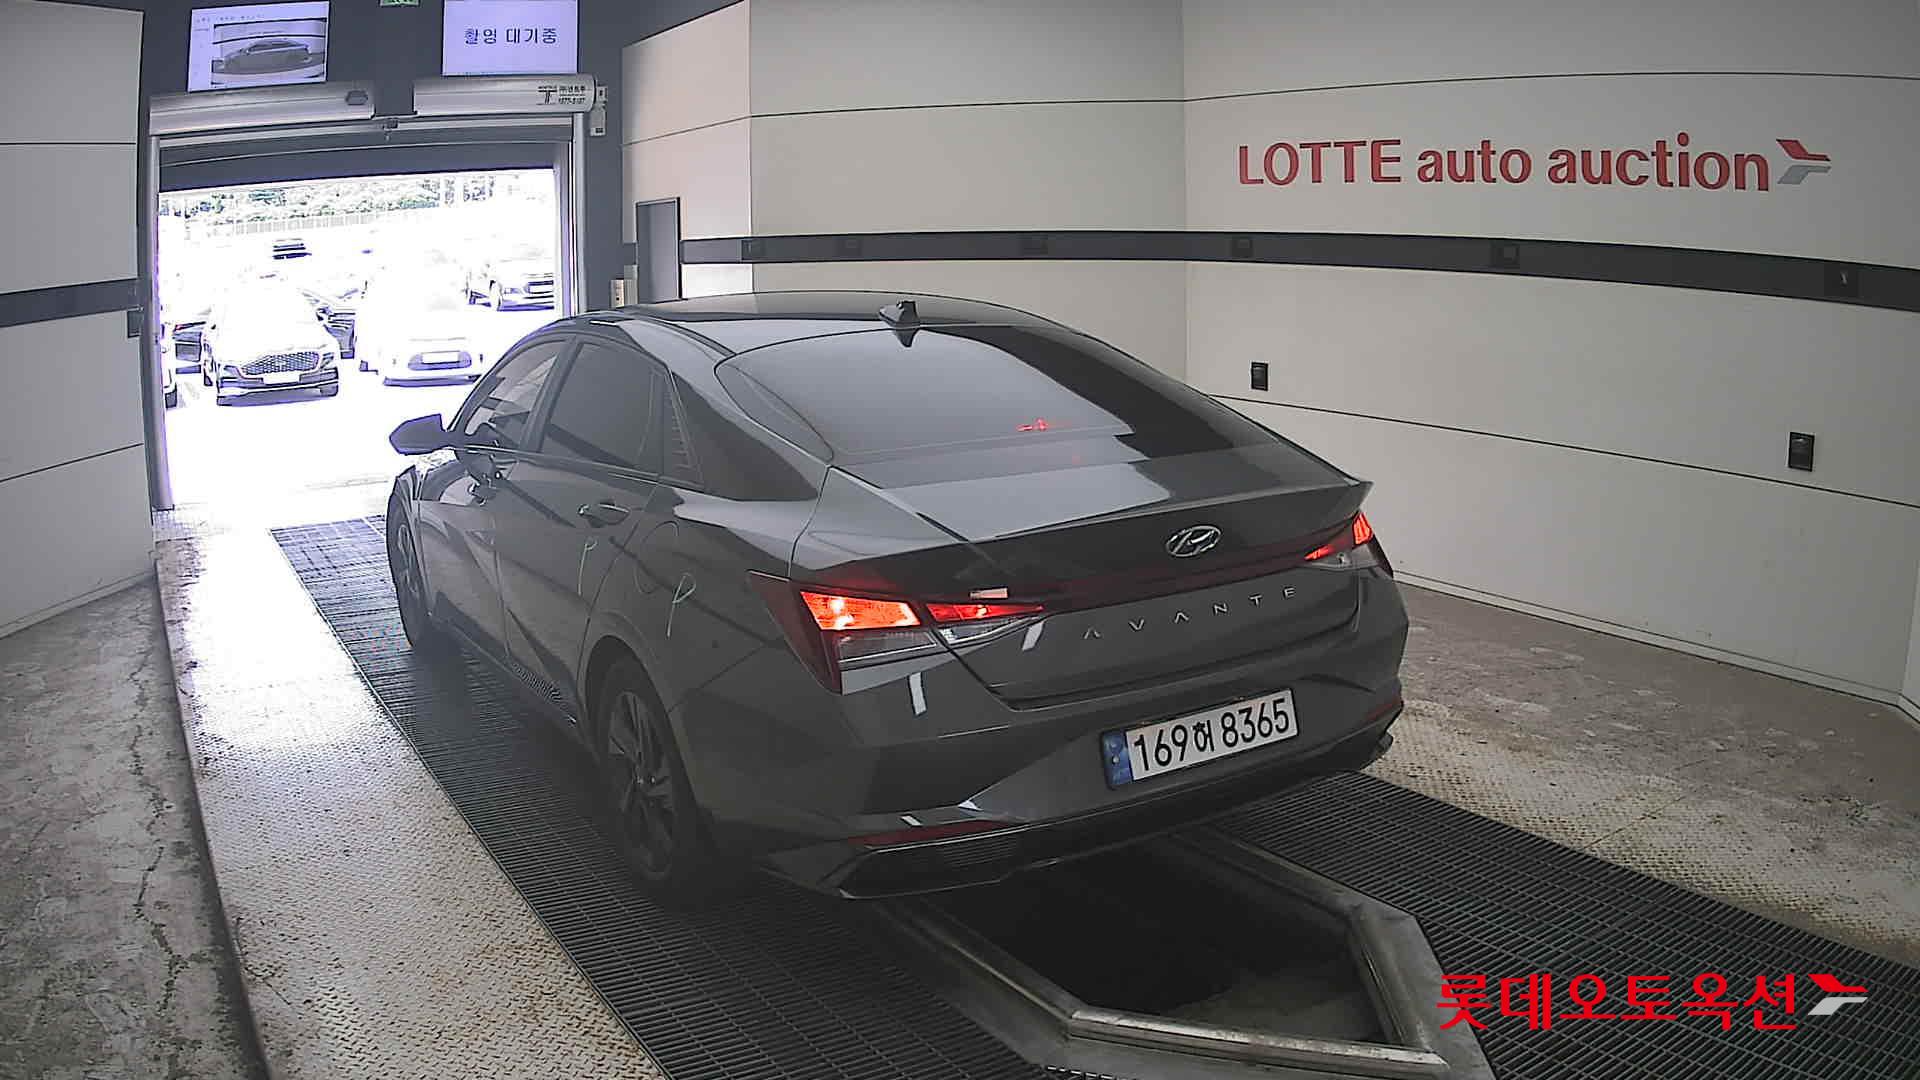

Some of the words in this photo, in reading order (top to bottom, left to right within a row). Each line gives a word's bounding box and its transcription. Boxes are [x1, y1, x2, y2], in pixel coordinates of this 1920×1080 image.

[506, 27, 558, 45] 대기중
[1239, 138, 1401, 185] LOTTE
[1417, 140, 1532, 185] auto
[1547, 132, 1770, 192] auction
[1083, 586, 1296, 640] AVANTE
[1221, 698, 1290, 749] 8365
